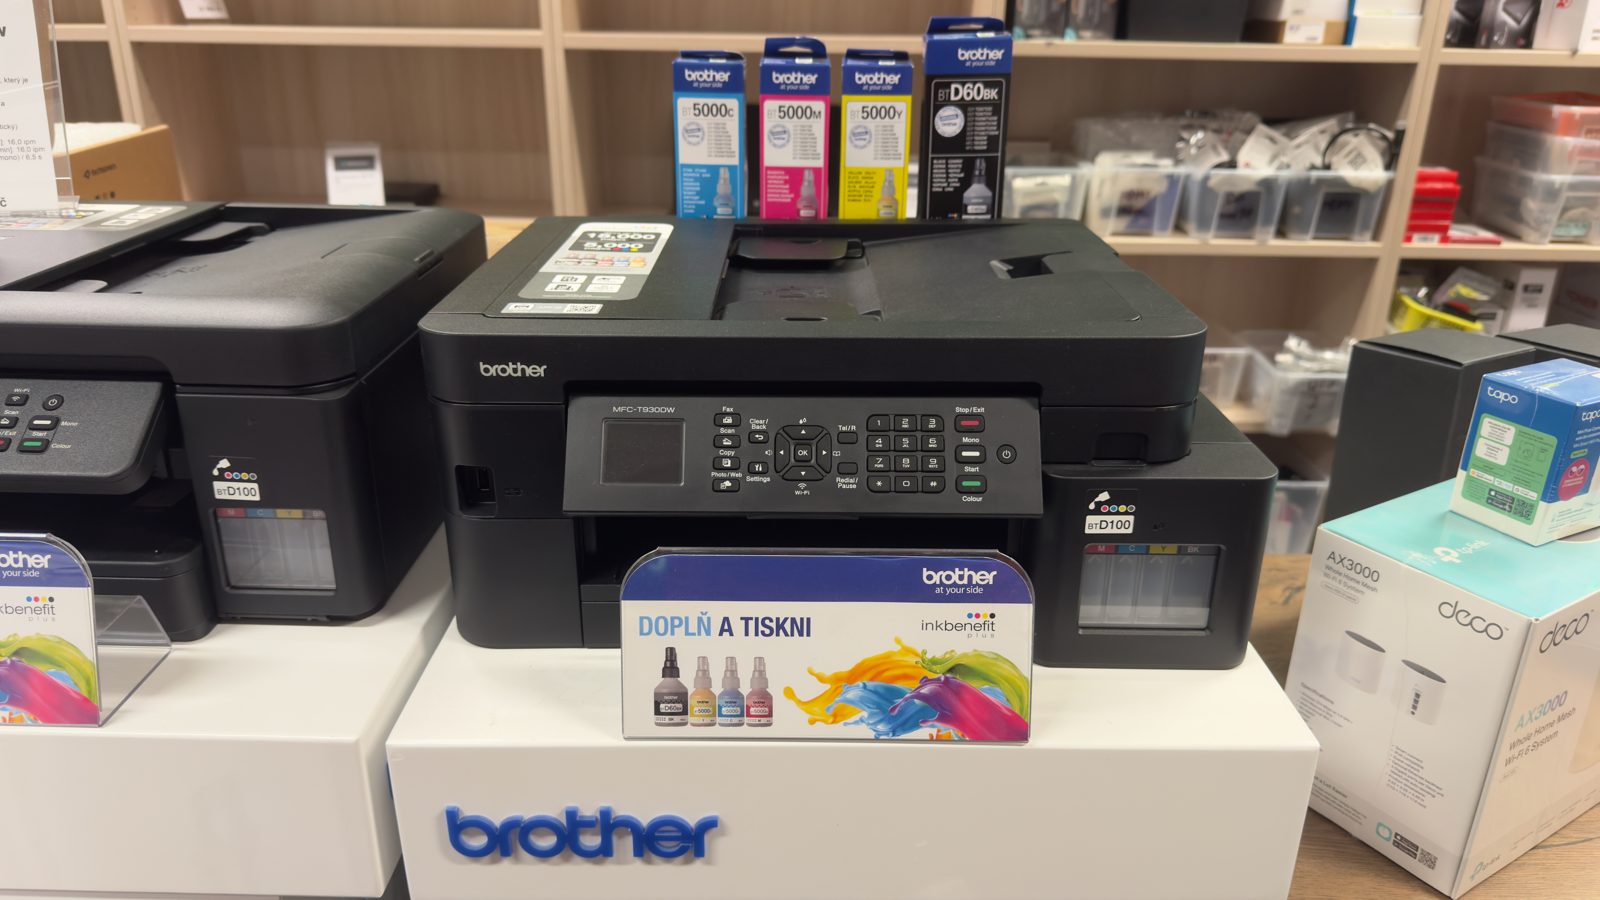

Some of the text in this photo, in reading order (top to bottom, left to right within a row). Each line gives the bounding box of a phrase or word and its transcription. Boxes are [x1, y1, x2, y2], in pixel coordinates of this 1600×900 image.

[958, 48, 1004, 60] brother
[685, 69, 730, 82] brother
[772, 71, 818, 84] brother
[855, 72, 901, 84] brother
[480, 362, 547, 377] brother
[1487, 386, 1518, 404] tapo
[2, 569, 40, 578] your side
[1327, 551, 1380, 582] AX3000
[922, 568, 997, 585] brother
[946, 587, 964, 595] your
[966, 586, 984, 594] side
[639, 611, 812, 637] DOPLŇ A TISKNI
[921, 620, 996, 632] inkbenefit
[1438, 601, 1503, 640] deco
[1538, 612, 1590, 654] deco
[1514, 690, 1568, 733] AX3000
[1509, 707, 1576, 751] Whole Home Mesh
[1530, 730, 1559, 752] System
[445, 805, 719, 859] brother
